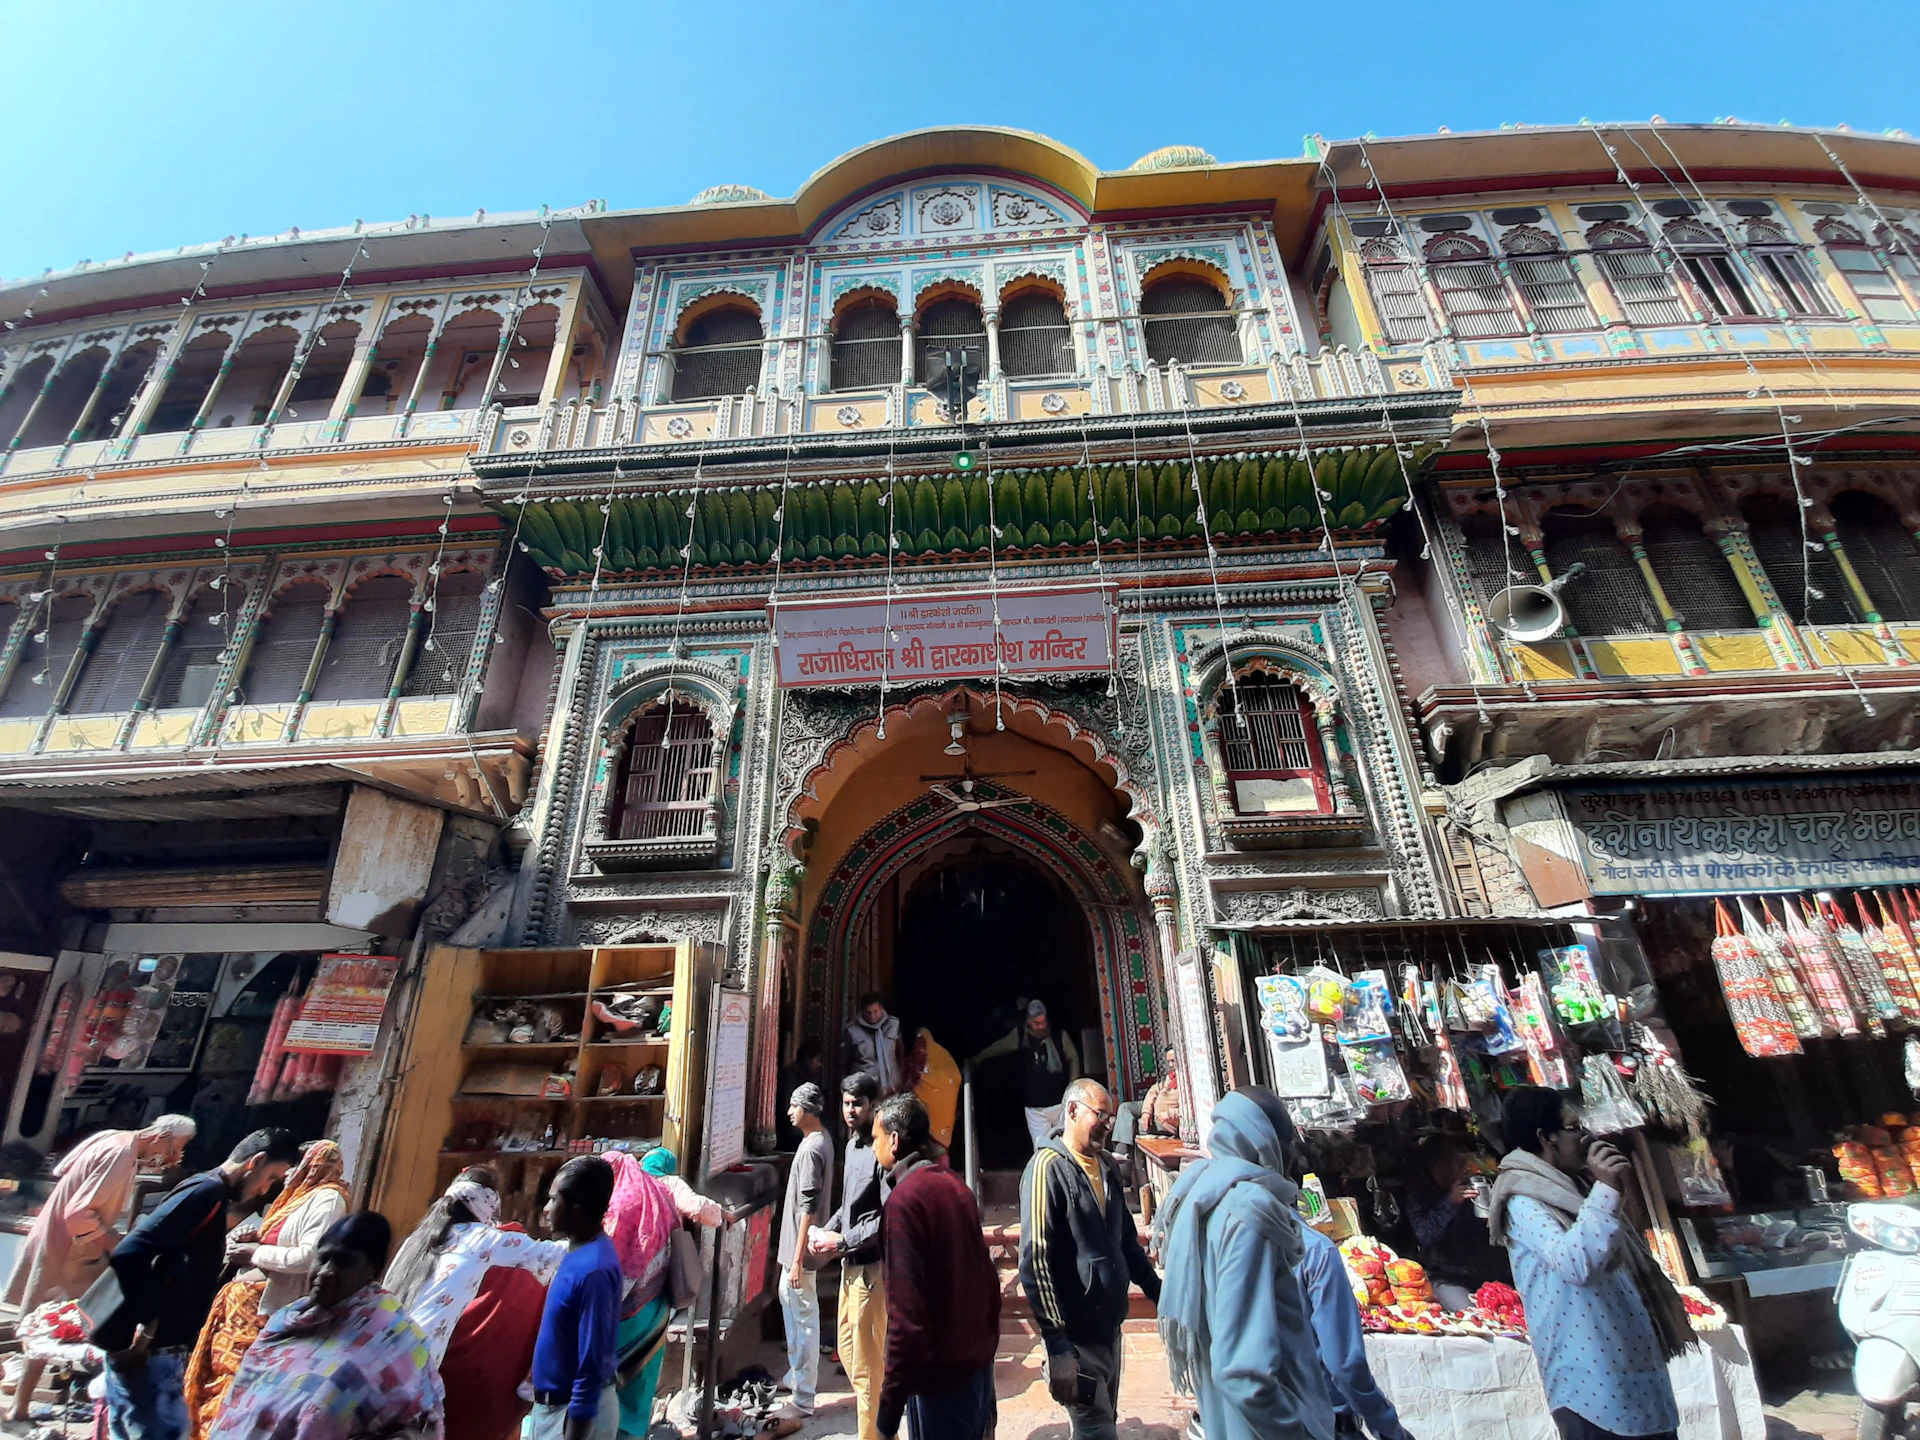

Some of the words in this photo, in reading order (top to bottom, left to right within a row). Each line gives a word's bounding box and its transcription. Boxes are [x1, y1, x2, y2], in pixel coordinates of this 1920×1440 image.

[908, 607, 919, 620] श्री
[797, 640, 895, 675] राजाधिराज
[900, 637, 925, 669] श्री
[929, 631, 1023, 671] द्वारकाधीश
[1028, 630, 1088, 662] मन्दिर
[1579, 791, 1616, 812] सुरेश
[1700, 806, 1787, 861] सुरेश
[1786, 811, 1852, 853] चन्द्र
[1599, 863, 1632, 880] गोटा
[1633, 860, 1664, 879] जरी
[1667, 859, 1700, 879] लैस
[1703, 857, 1772, 881] पोशाकों
[1773, 855, 1795, 878] के
[1797, 853, 1849, 879] कपड़े
